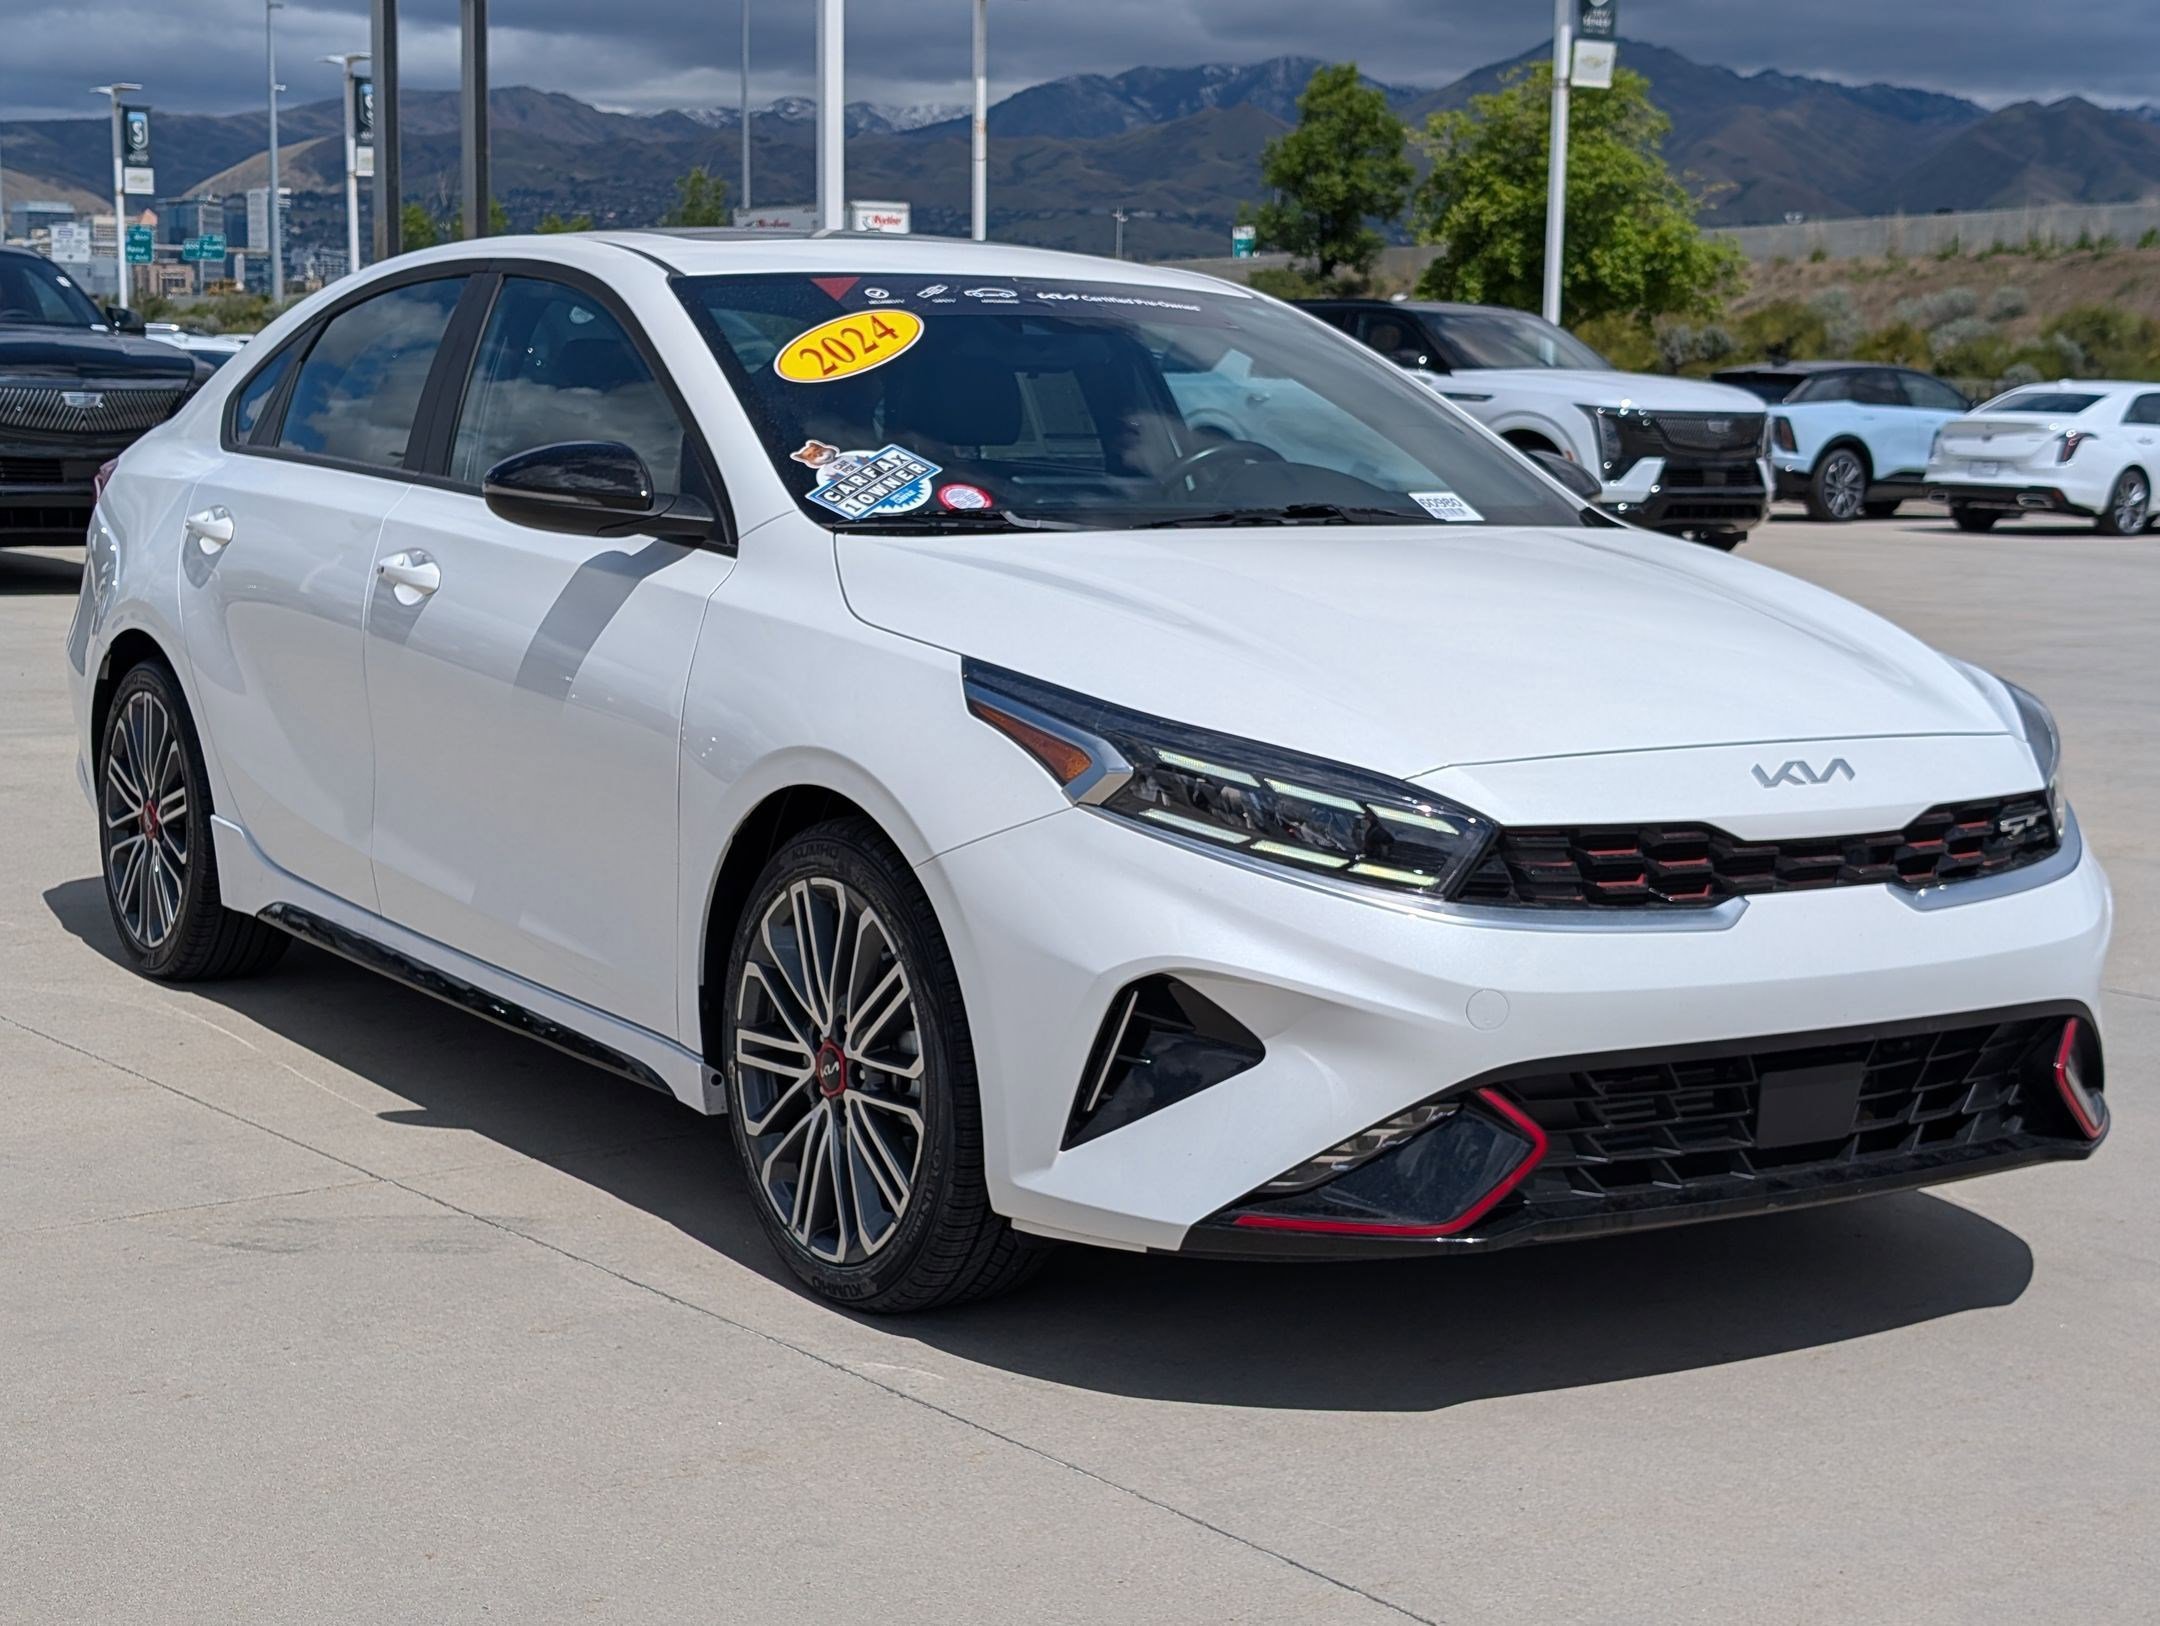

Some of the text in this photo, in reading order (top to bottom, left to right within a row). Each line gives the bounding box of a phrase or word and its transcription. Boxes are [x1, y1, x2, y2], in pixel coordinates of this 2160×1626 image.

[799, 315, 899, 376] 2024
[823, 454, 909, 502] CARFAX
[857, 463, 928, 504] OWNER
[1750, 758, 1856, 789] KIA
